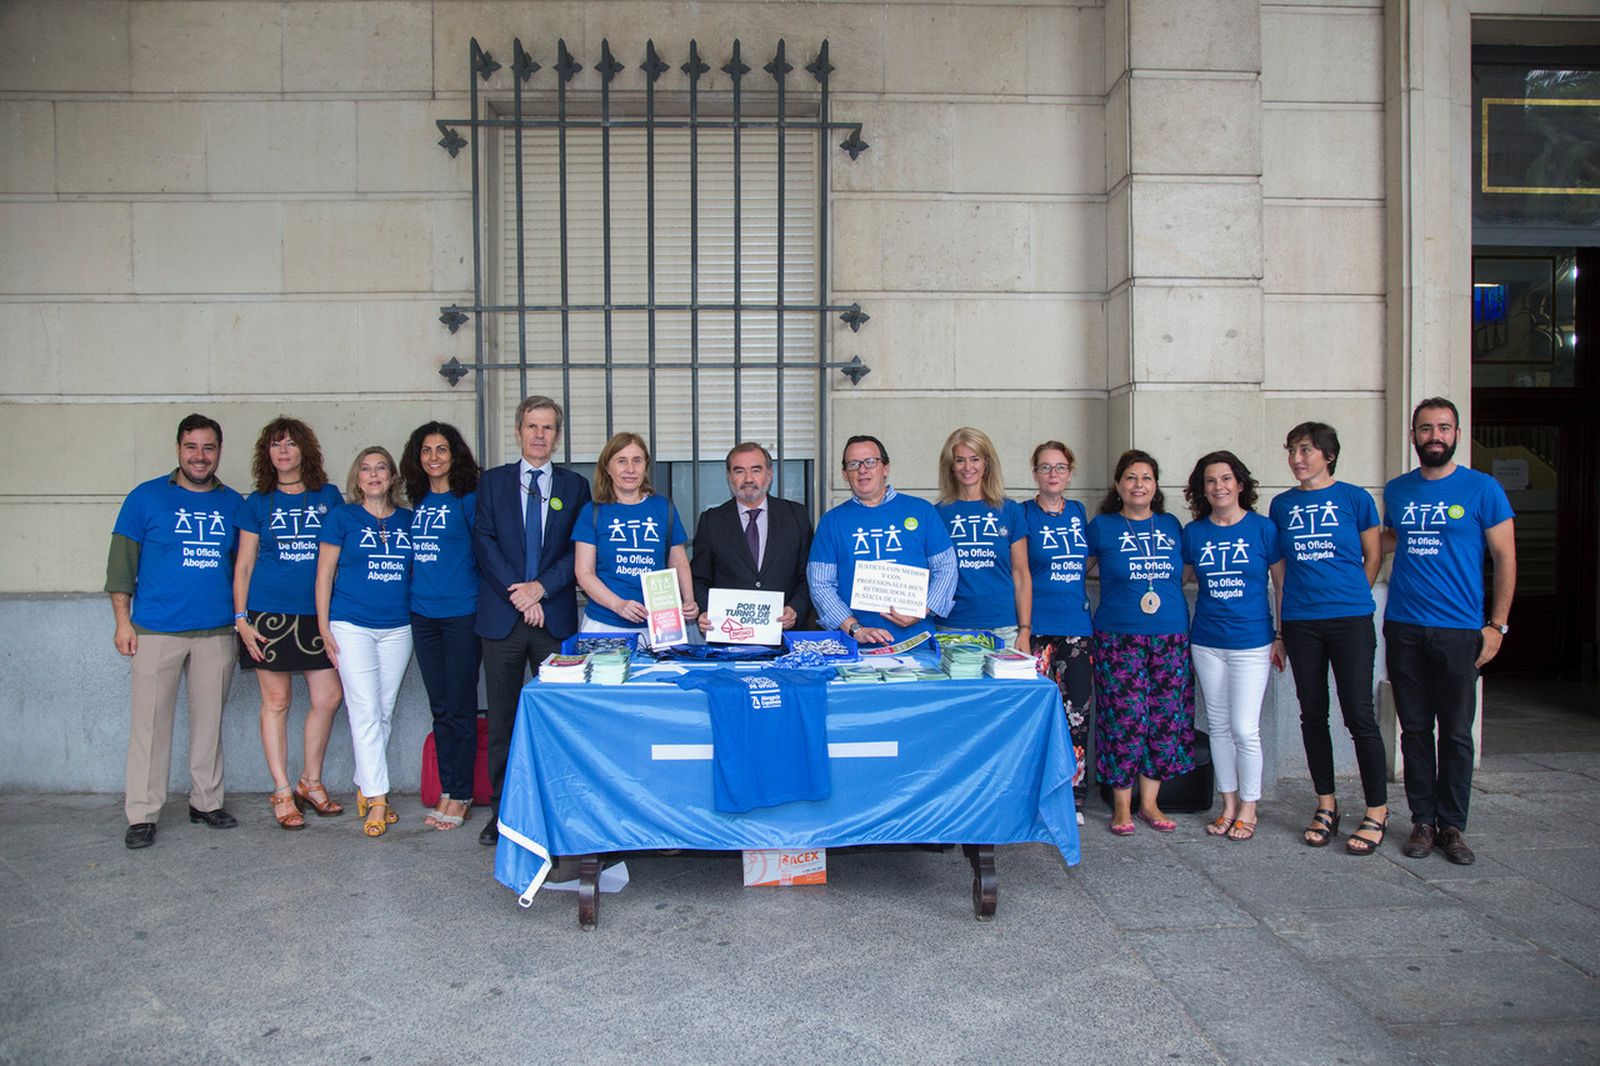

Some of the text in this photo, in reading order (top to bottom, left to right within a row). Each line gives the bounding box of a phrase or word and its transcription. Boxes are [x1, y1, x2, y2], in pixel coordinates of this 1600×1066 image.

[291, 541, 318, 551] Oficio,
[1294, 541, 1336, 551] De Oficio,
[1418, 537, 1442, 547] Oficio,
[183, 547, 221, 558] De Oficio,
[279, 551, 315, 562] Abogada
[958, 548, 997, 559] De Oficio,
[1297, 551, 1334, 561] Abogada
[183, 558, 218, 569] Abogado
[616, 554, 656, 565] De Oficio,
[959, 559, 994, 569] Abogada
[368, 561, 405, 571] De Oficio,
[1051, 562, 1061, 570] De
[1129, 561, 1174, 571] De Oficio,
[367, 571, 402, 582] Abogada
[1129, 571, 1170, 581] Abogada
[1208, 578, 1245, 588] De Oficio,
[737, 602, 756, 610] POR
[725, 609, 756, 617] TURNO
[740, 617, 770, 625] OFICIO
